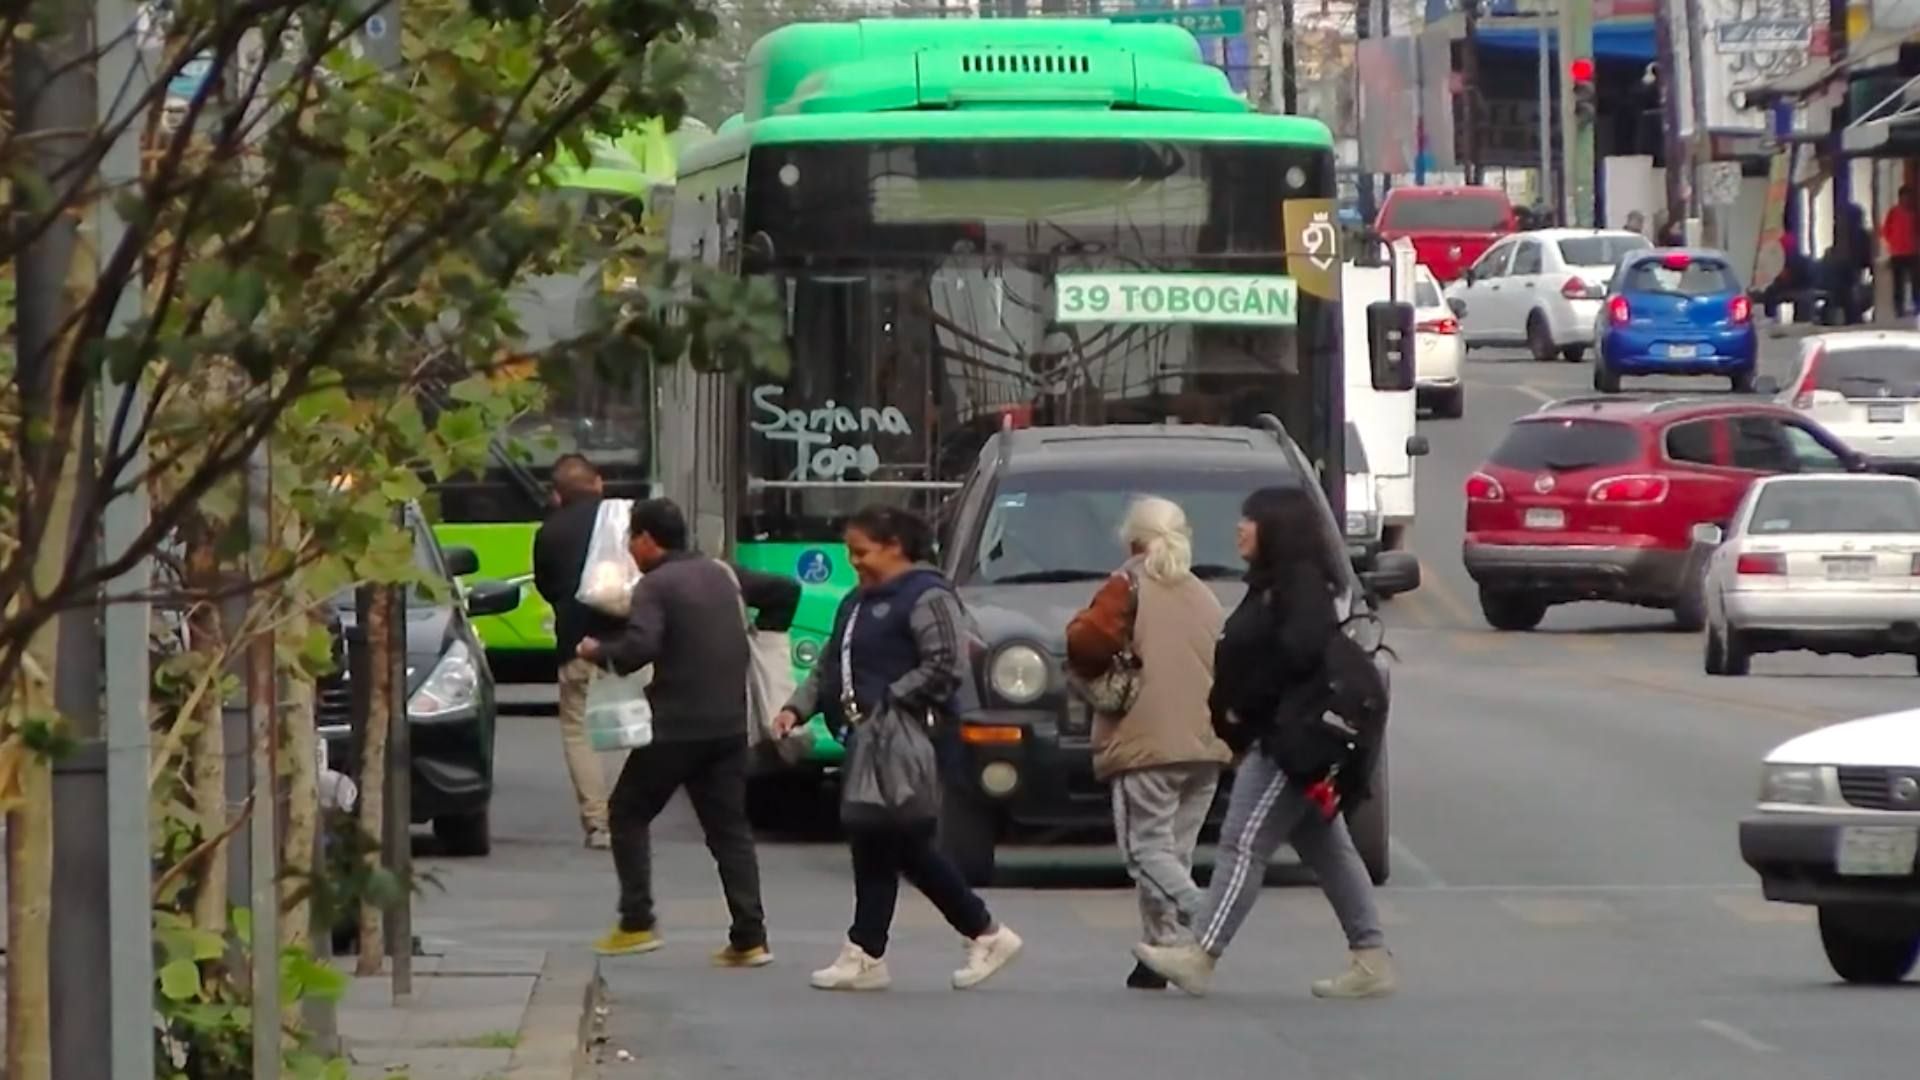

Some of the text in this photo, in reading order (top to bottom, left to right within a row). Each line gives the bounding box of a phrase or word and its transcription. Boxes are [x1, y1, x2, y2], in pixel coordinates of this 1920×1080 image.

[1064, 279, 1289, 315] 39 TOBOGÁN
[751, 384, 912, 435] Soriana
